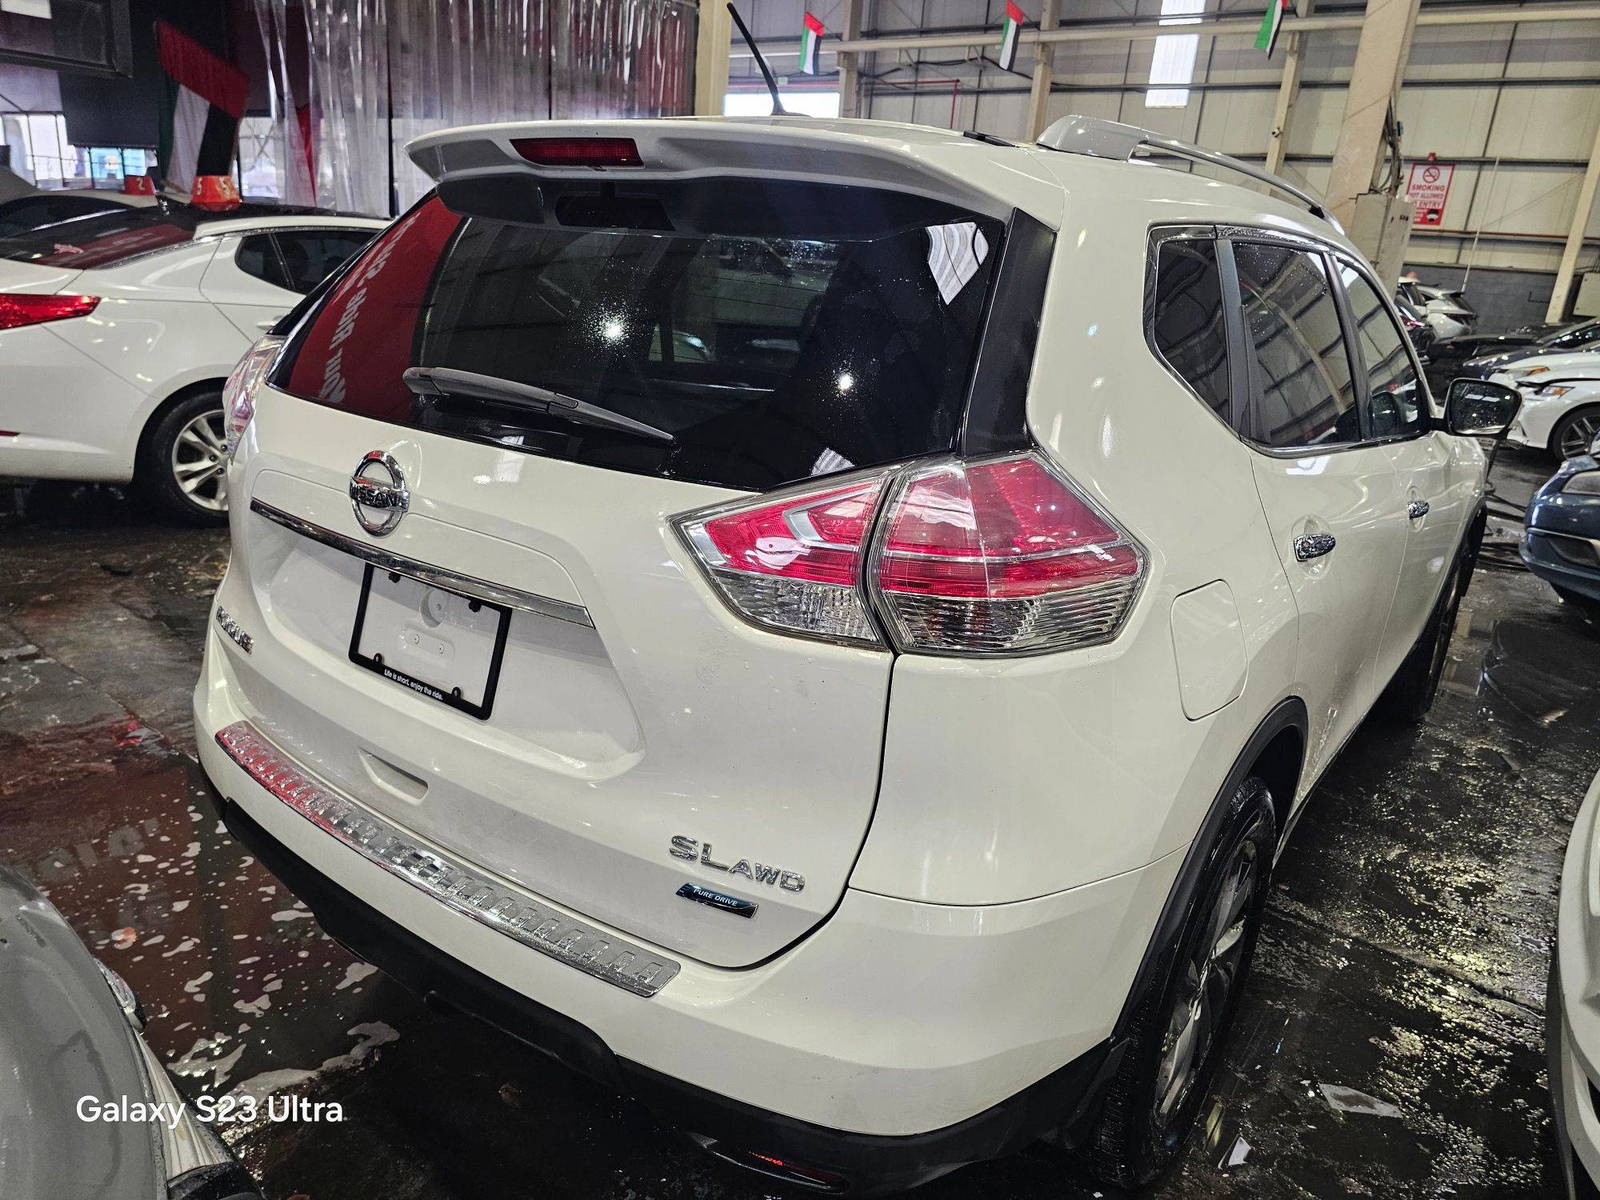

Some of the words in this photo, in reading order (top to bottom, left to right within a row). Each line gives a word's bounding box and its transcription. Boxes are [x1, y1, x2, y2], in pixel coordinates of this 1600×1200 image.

[410, 682, 423, 692] enjoy
[423, 687, 432, 695] the
[693, 888, 713, 900] PURE
[714, 895, 738, 907] DRIVE
